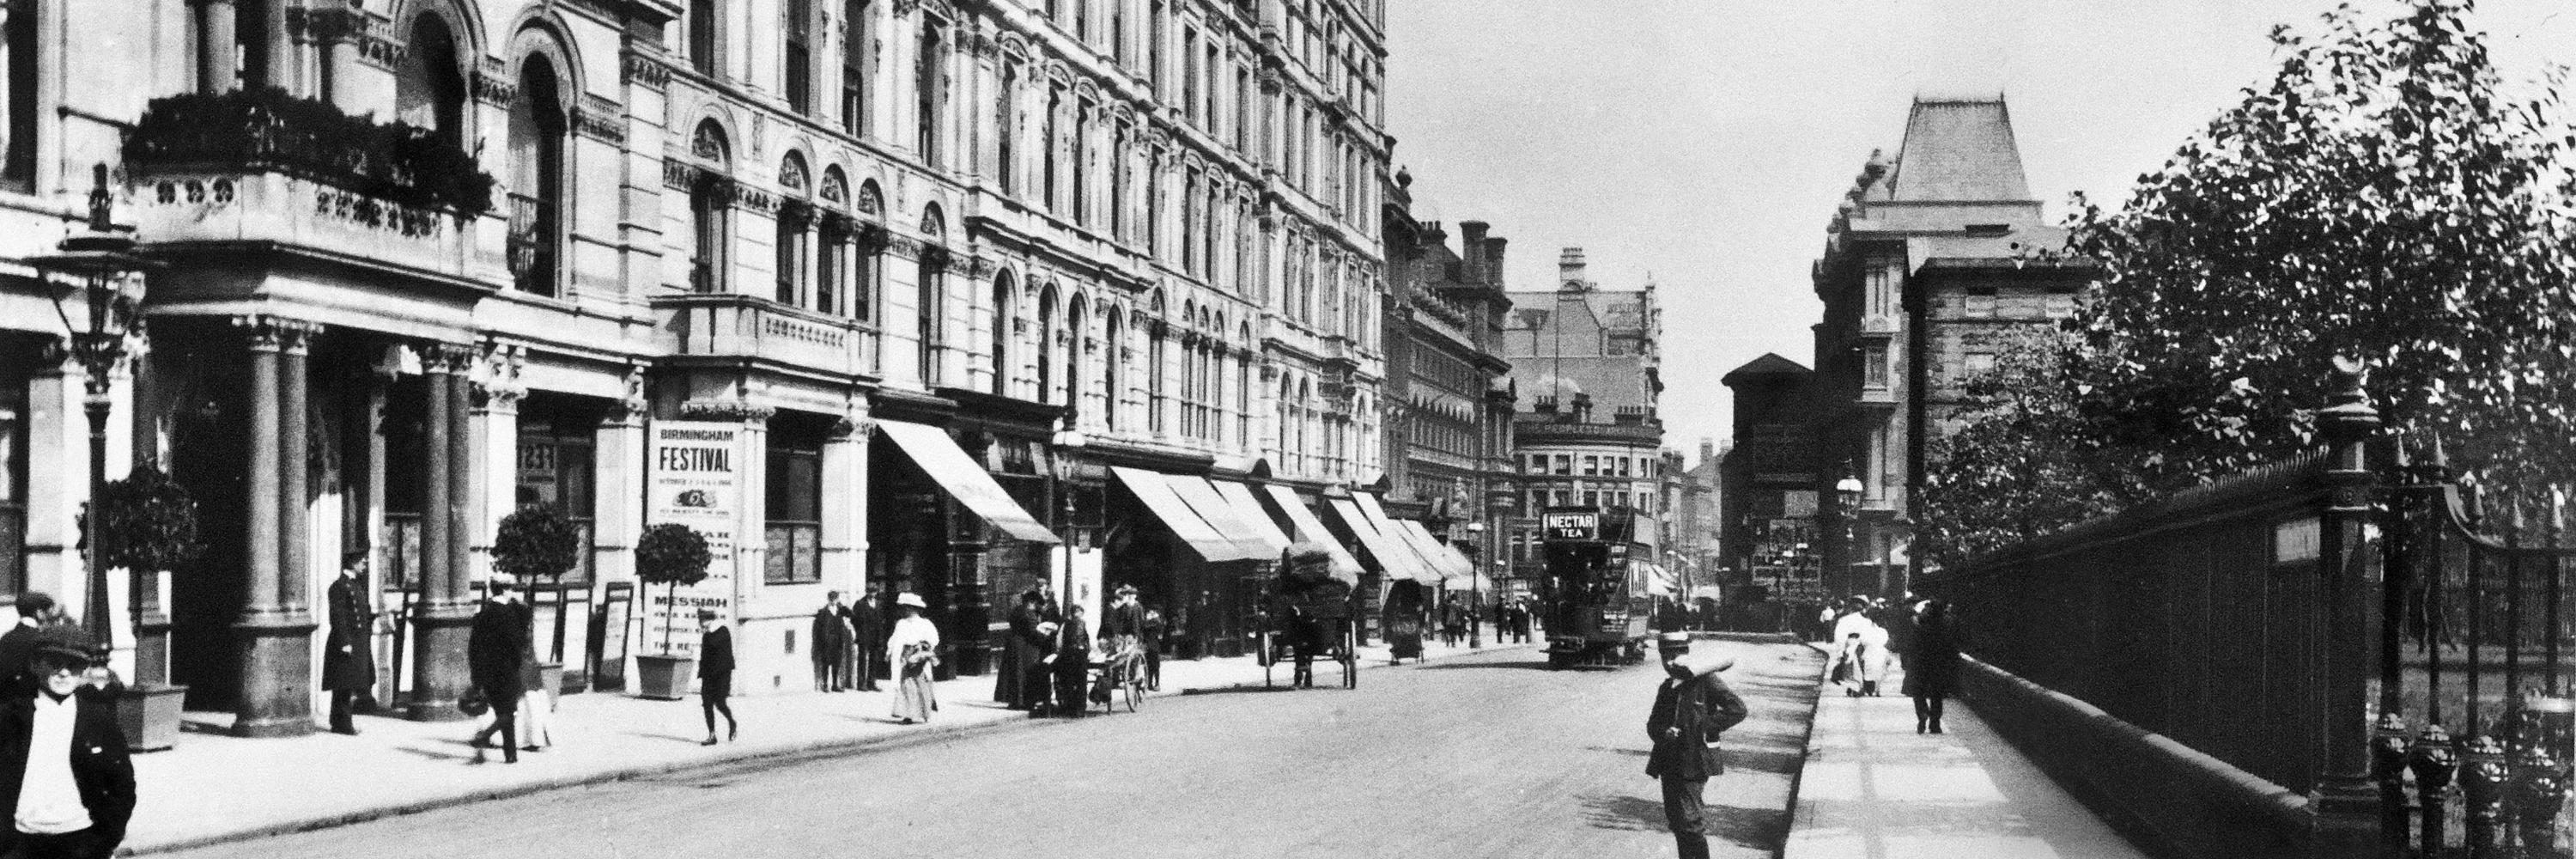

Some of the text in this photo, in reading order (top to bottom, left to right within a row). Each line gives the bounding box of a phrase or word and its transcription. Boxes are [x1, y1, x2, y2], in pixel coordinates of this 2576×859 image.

[660, 430, 733, 441] BIRMINGHAM
[659, 447, 732, 472] FESTIVAL
[1549, 515, 1593, 527] NECTAR
[1560, 528, 1583, 538] TEA
[654, 596, 727, 607] MESSIAH
